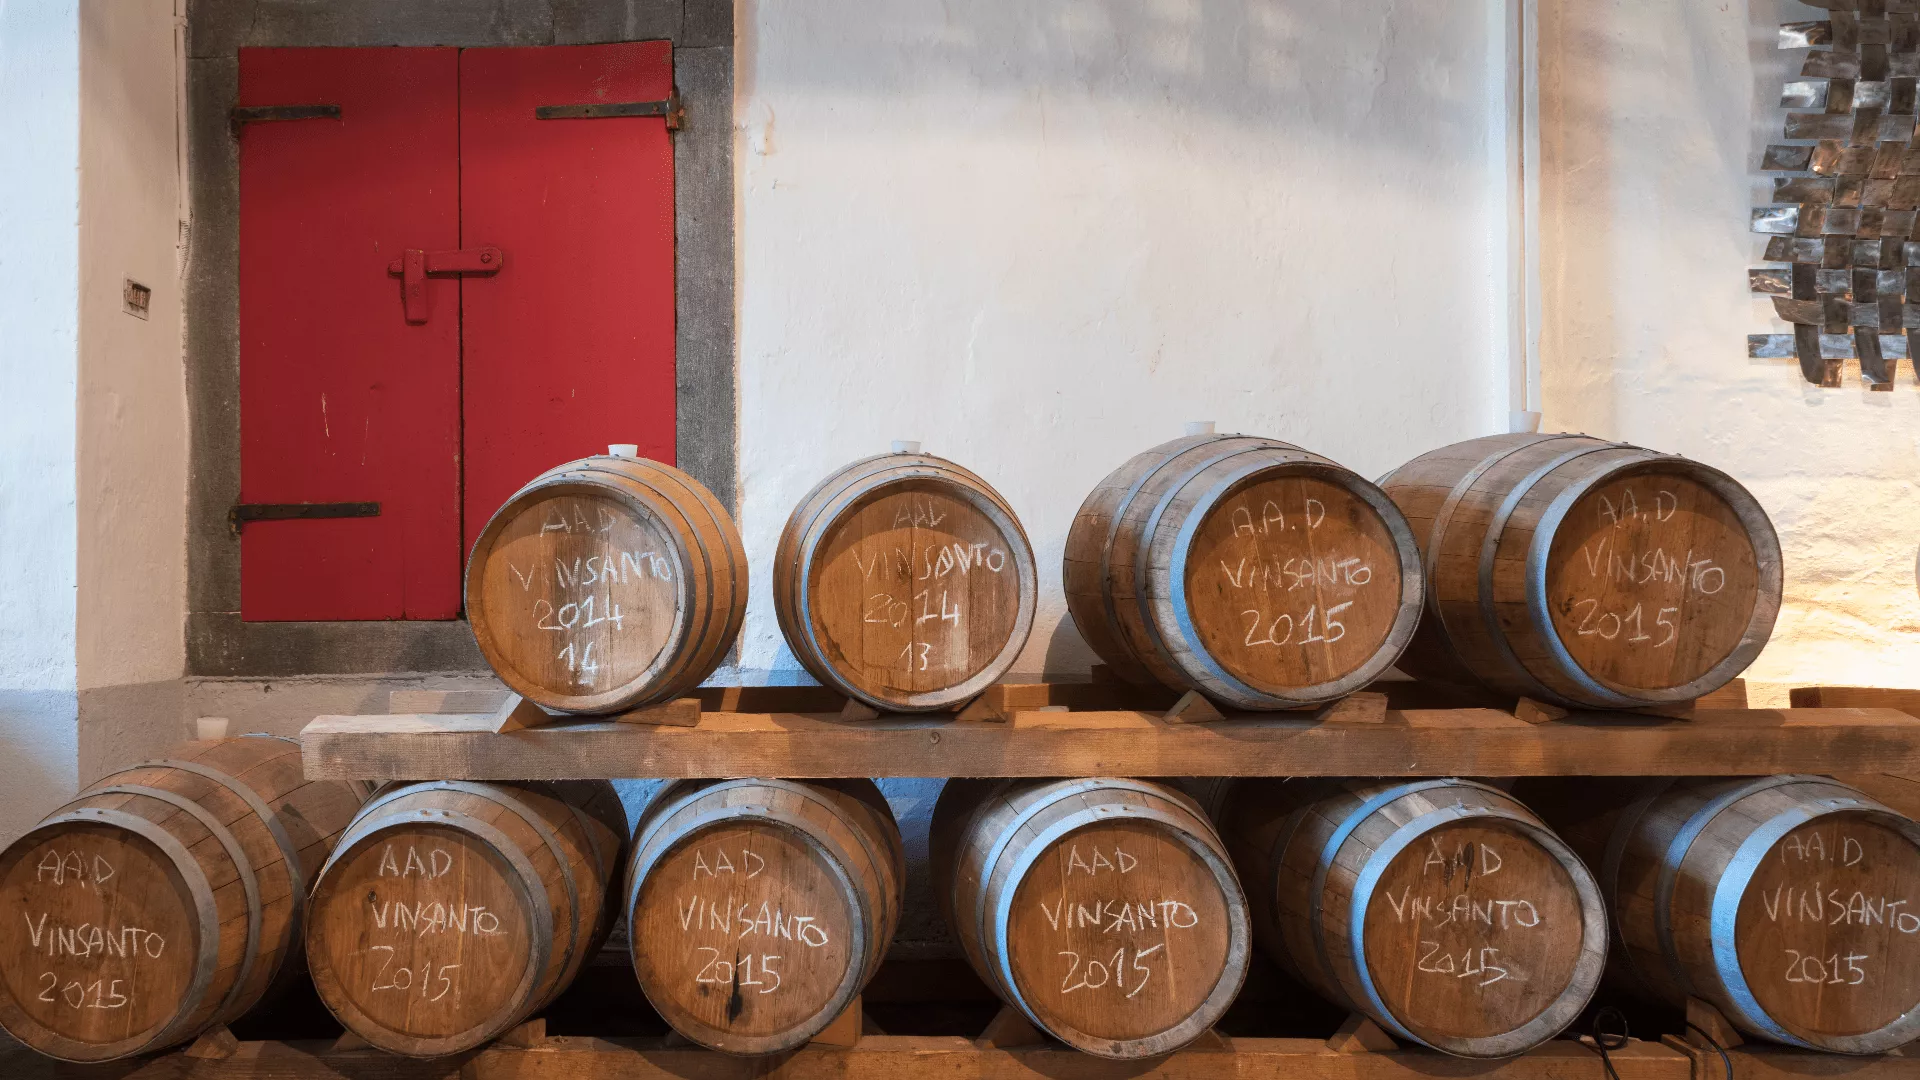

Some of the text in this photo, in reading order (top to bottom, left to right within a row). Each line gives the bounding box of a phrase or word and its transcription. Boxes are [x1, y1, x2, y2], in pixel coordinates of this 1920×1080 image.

[852, 542, 1004, 582] VINSANTO
[1585, 537, 1725, 594] VINSANTO
[532, 595, 624, 630] 2014
[864, 590, 960, 628] 2014
[1241, 601, 1353, 647] 2015
[1575, 599, 1678, 648] 2015
[898, 642, 931, 674] 13
[693, 850, 765, 880] AAD
[1068, 845, 1137, 875] AAD
[372, 901, 499, 938] VINSANTO
[678, 895, 828, 947] VINSANTO
[1041, 898, 1198, 934] VINSANTO
[1386, 886, 1539, 929] VINSANTO
[1763, 881, 1920, 933] VINSANTO
[25, 912, 164, 958] VINSANTO
[371, 945, 462, 1002] 2015
[696, 947, 782, 994] 2015
[1058, 943, 1164, 998] 2015
[1418, 941, 1507, 987] 2015
[1785, 949, 1868, 984] 2015
[38, 972, 127, 1009] 2015
